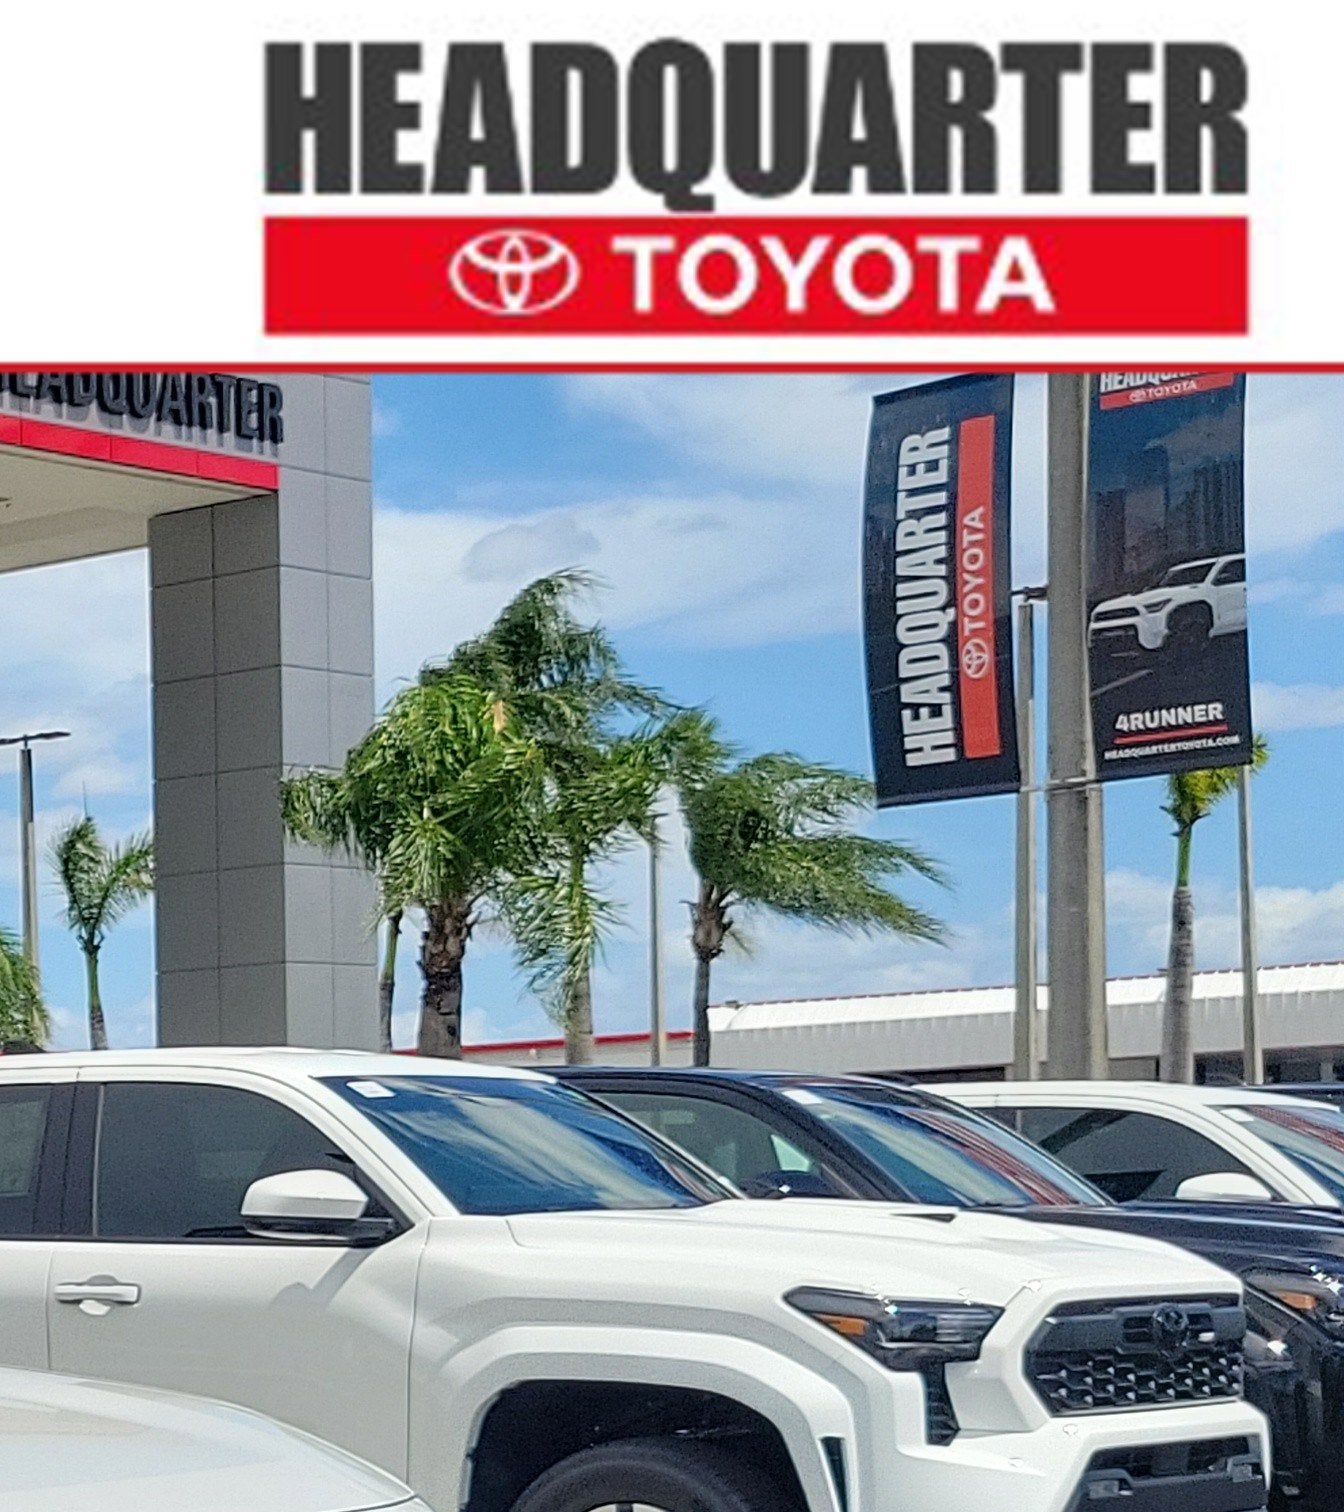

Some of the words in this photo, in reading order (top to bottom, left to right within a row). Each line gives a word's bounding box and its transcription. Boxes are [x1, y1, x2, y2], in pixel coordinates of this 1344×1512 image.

[1148, 379, 1197, 399] TOYOTA
[895, 426, 957, 767] HEADQUARTER
[962, 505, 987, 636] TOYOTA
[1115, 701, 1224, 732] 4RUNNER
